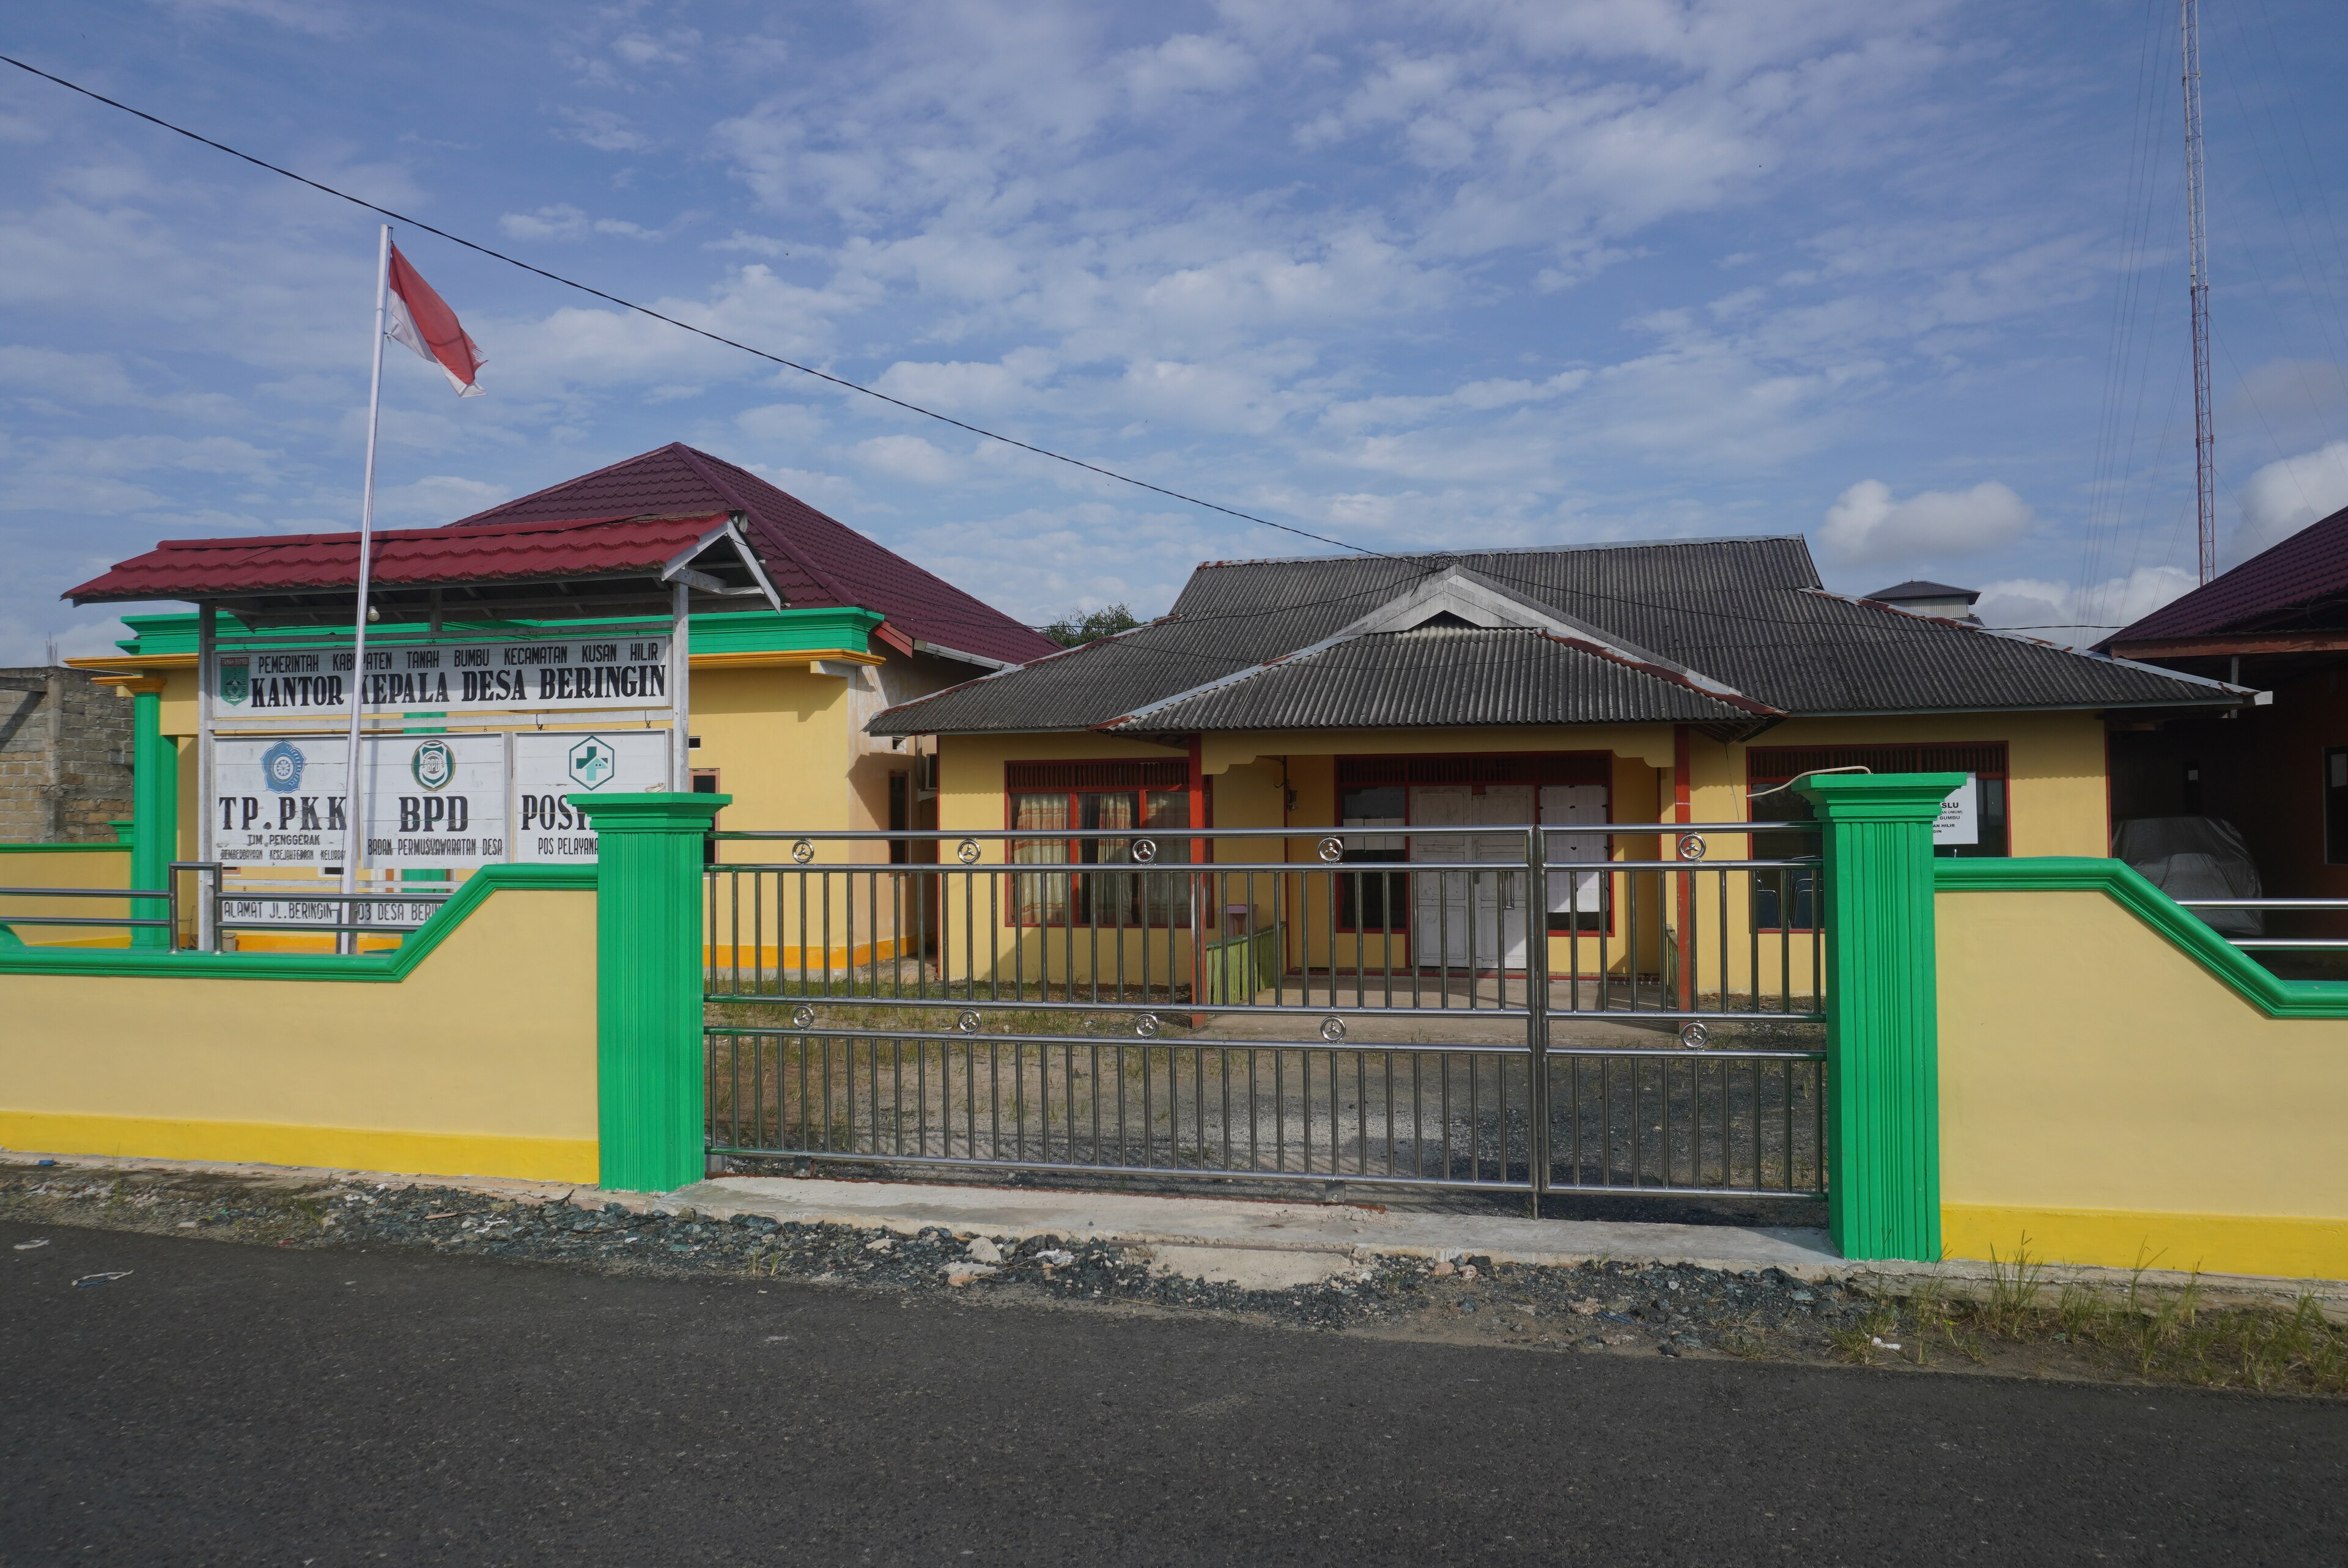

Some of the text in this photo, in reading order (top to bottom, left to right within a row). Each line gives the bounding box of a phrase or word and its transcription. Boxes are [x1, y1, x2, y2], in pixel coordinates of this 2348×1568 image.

[259, 655, 319, 674] PEMERINTAH
[407, 650, 440, 669] TANAH
[454, 649, 490, 667] BUMBU
[504, 646, 567, 666] KECAMATAN
[582, 644, 617, 663] KUSAN
[630, 642, 659, 661] HILIR
[251, 675, 344, 708] KANTOR
[462, 669, 527, 702] DESA
[539, 665, 666, 700] BERINGIN
[426, 758, 440, 771] BPD
[219, 797, 347, 830] TP.PKK
[399, 796, 468, 832] BPD
[248, 834, 320, 846] TIM PENGGERAK
[368, 838, 503, 856] BADAN PERMUSYAWARATAN DESA
[539, 837, 598, 855] POS PELAYANA
[224, 902, 263, 919] ALAMAT
[378, 904, 404, 921] DESA
